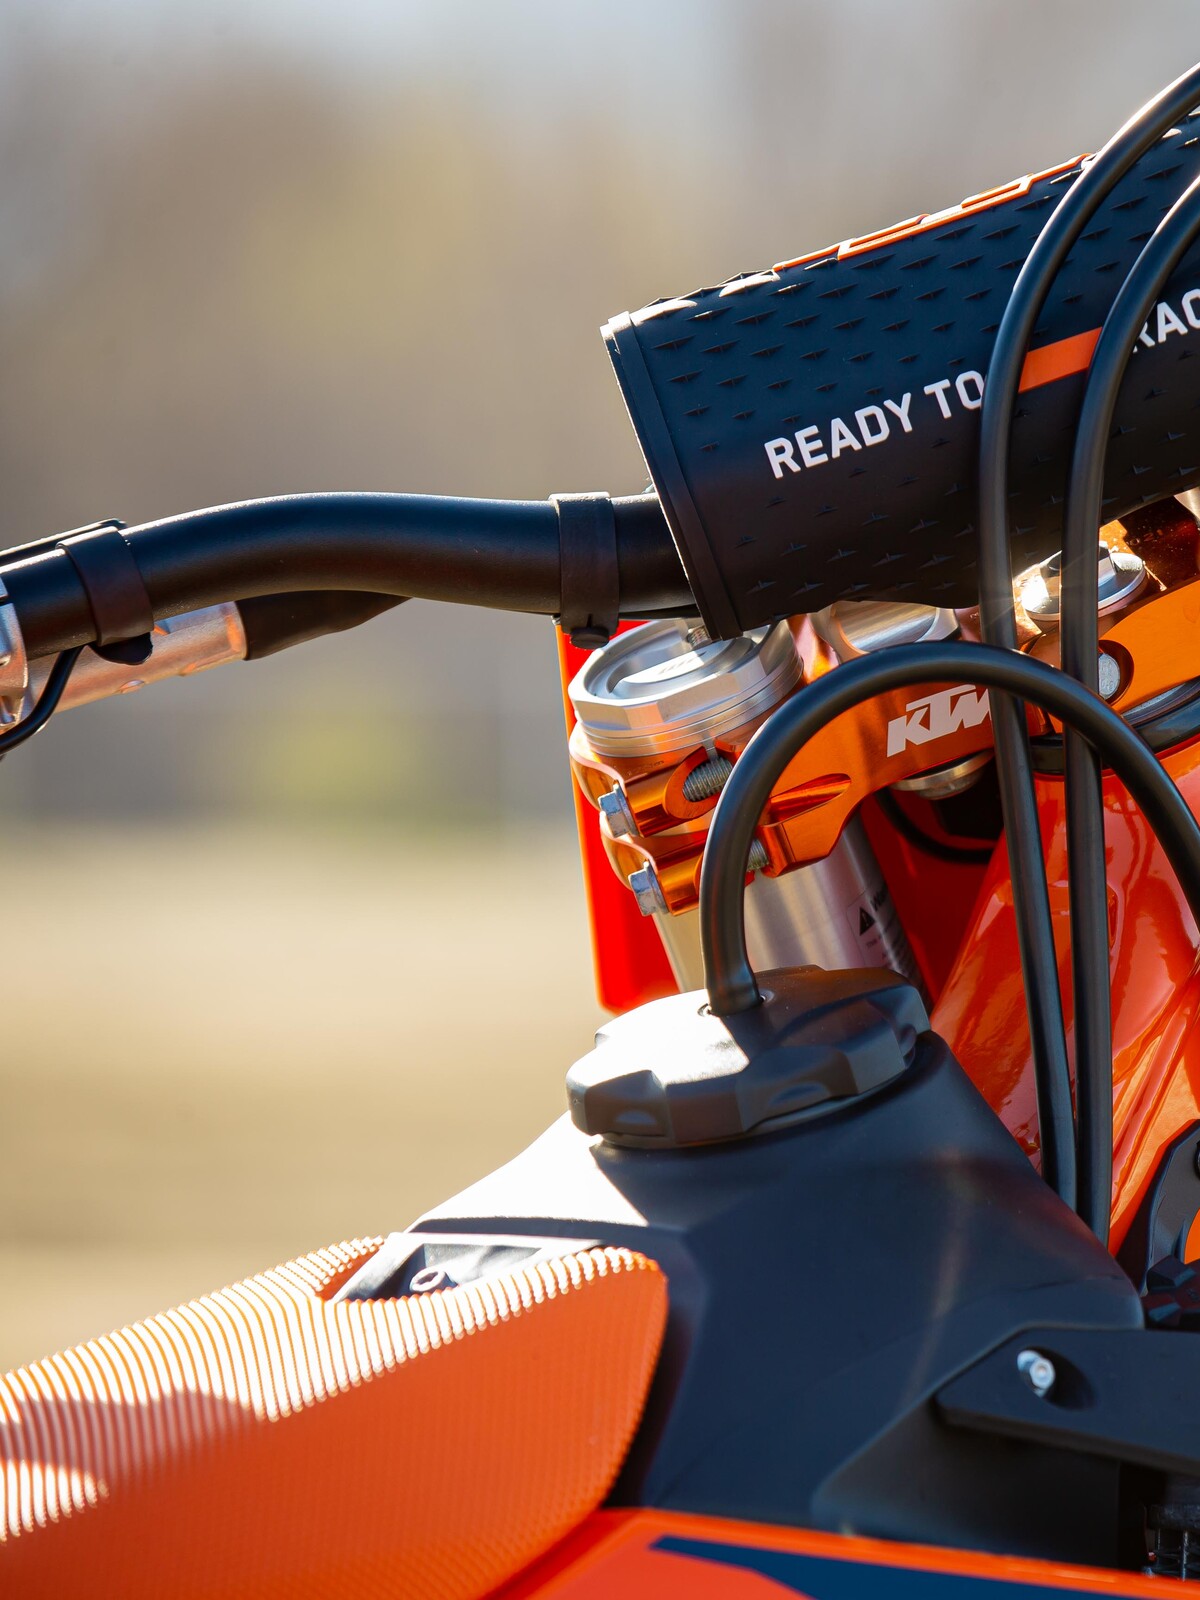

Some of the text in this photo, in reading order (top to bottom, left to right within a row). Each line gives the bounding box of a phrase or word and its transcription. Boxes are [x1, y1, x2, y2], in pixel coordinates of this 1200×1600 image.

[763, 392, 913, 479] READY
[923, 370, 985, 419] TO
[886, 684, 991, 757] KTM
